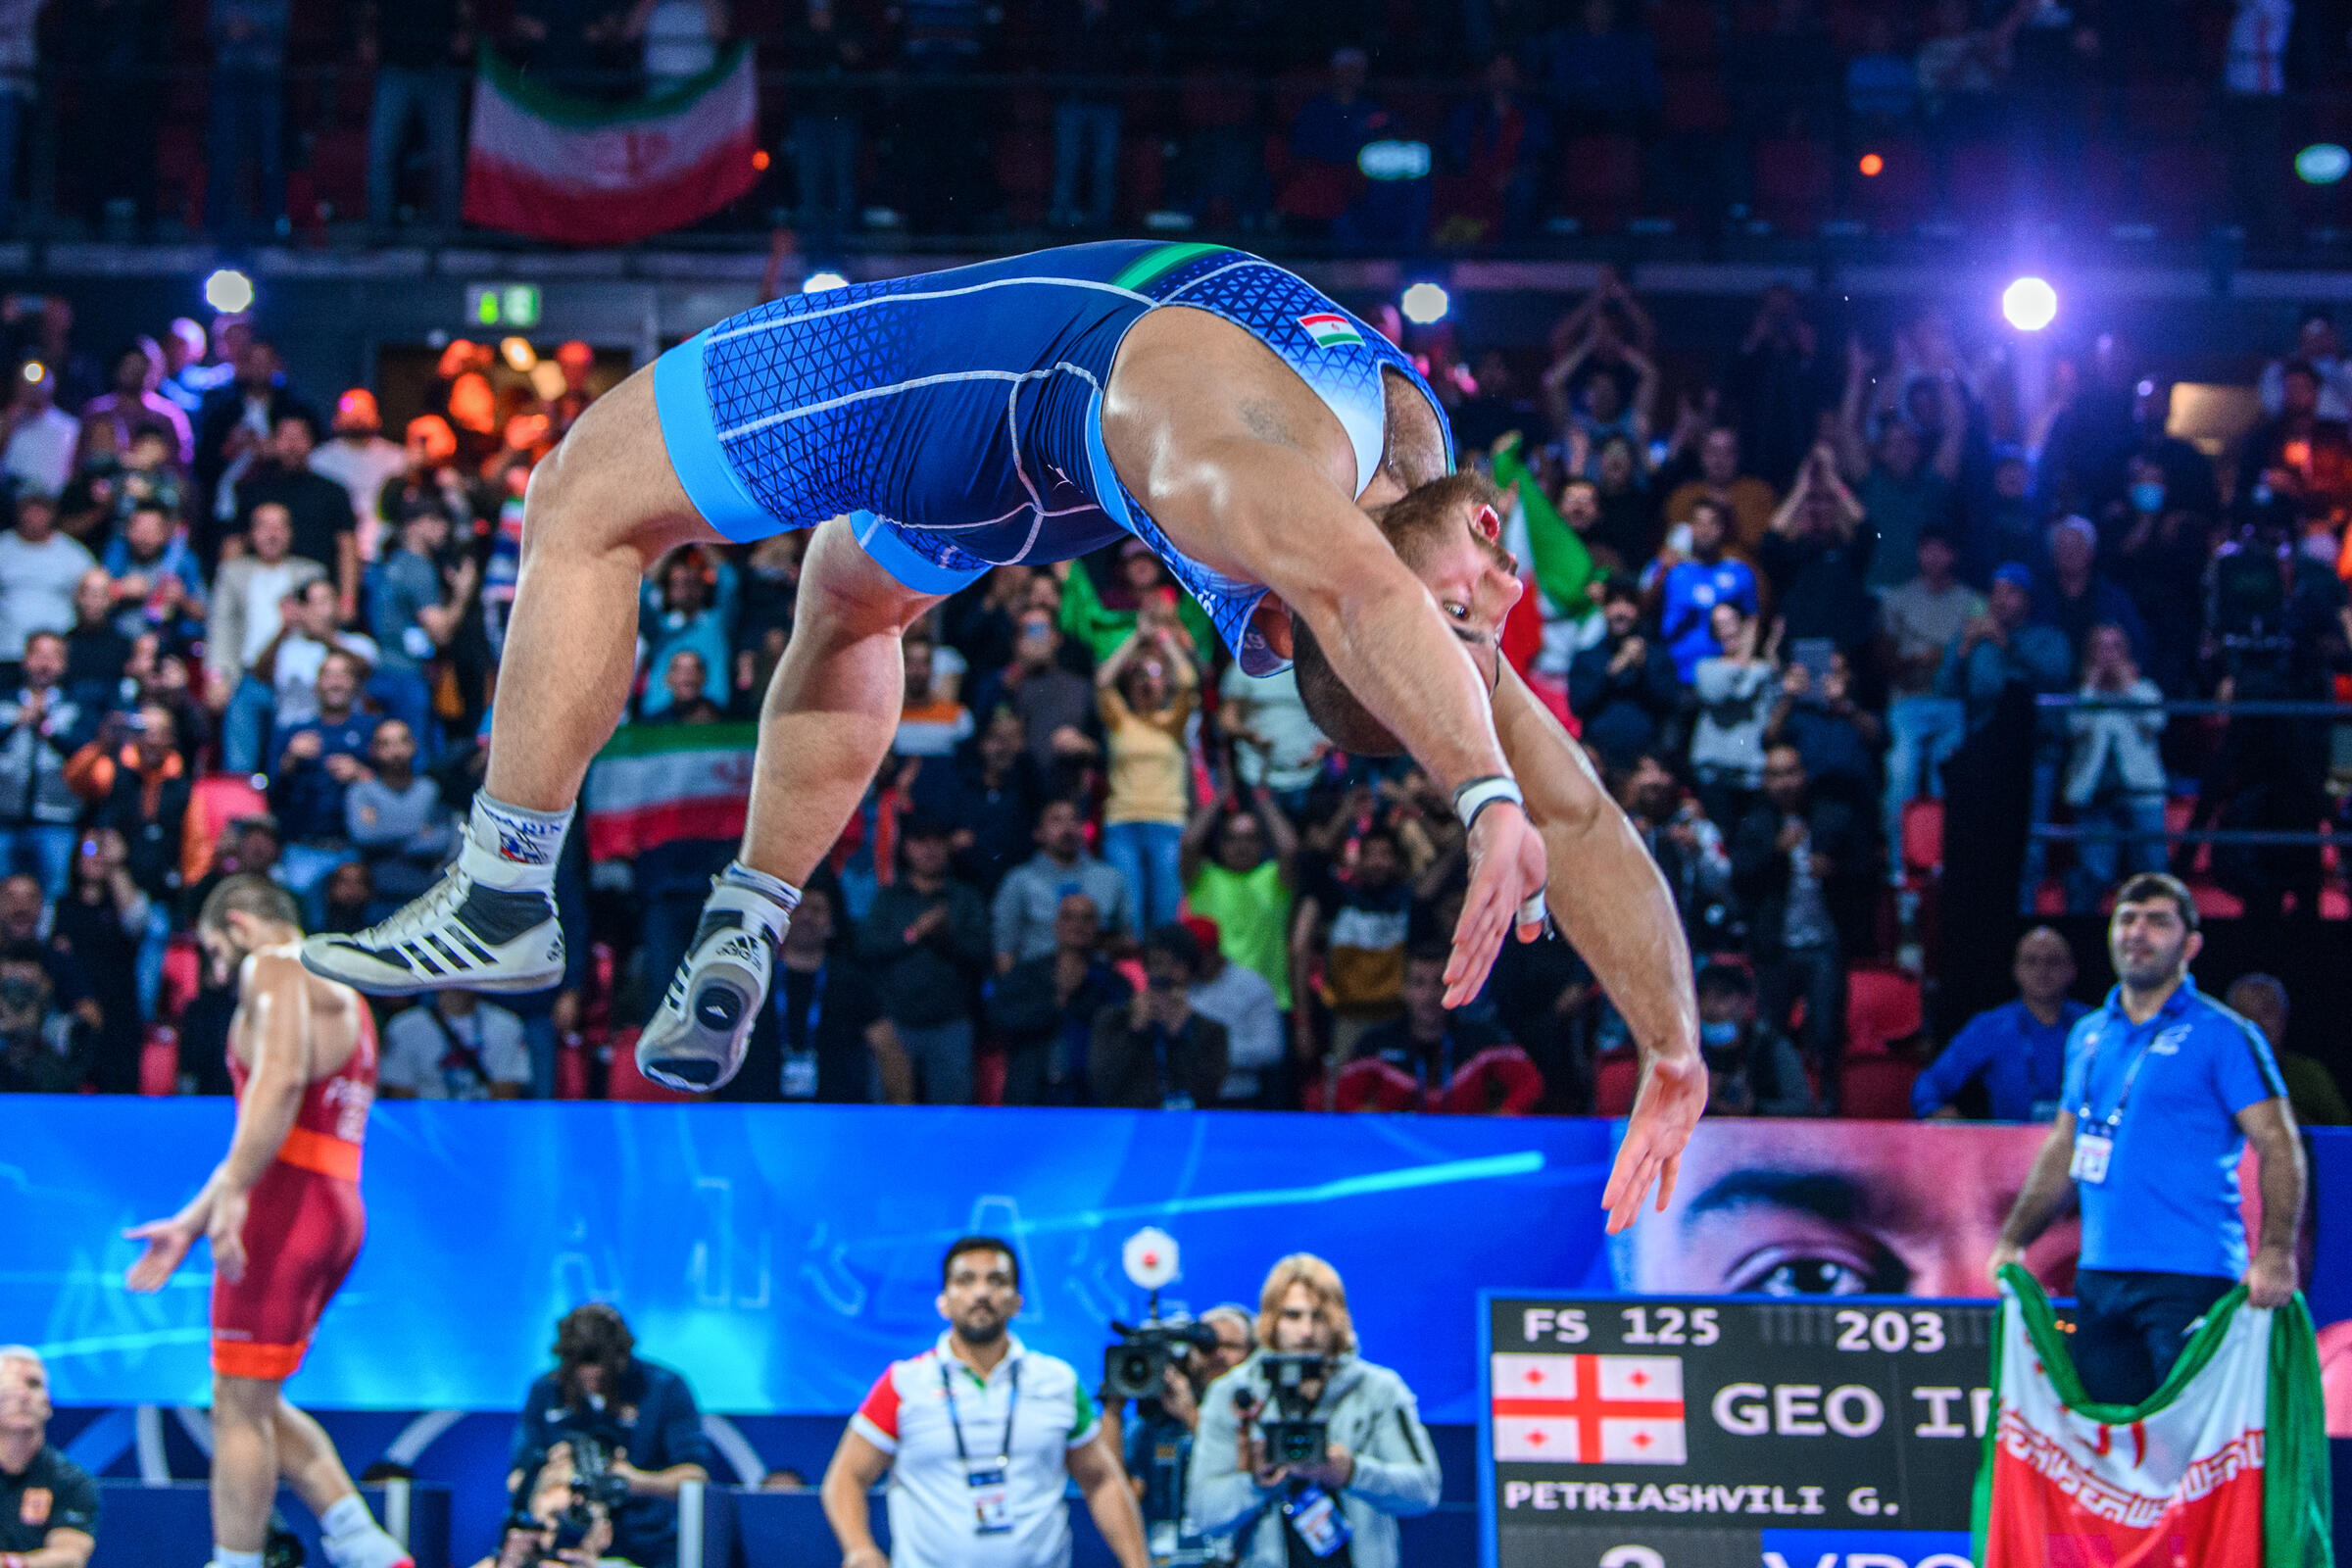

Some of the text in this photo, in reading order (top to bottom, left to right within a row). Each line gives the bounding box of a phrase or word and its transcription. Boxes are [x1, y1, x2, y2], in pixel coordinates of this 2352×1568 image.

[1524, 1306, 1946, 1352] FS 125 203
[1712, 1383, 1885, 1438] GEO
[1504, 1481, 1900, 1516] PETRIASHVILI G.
